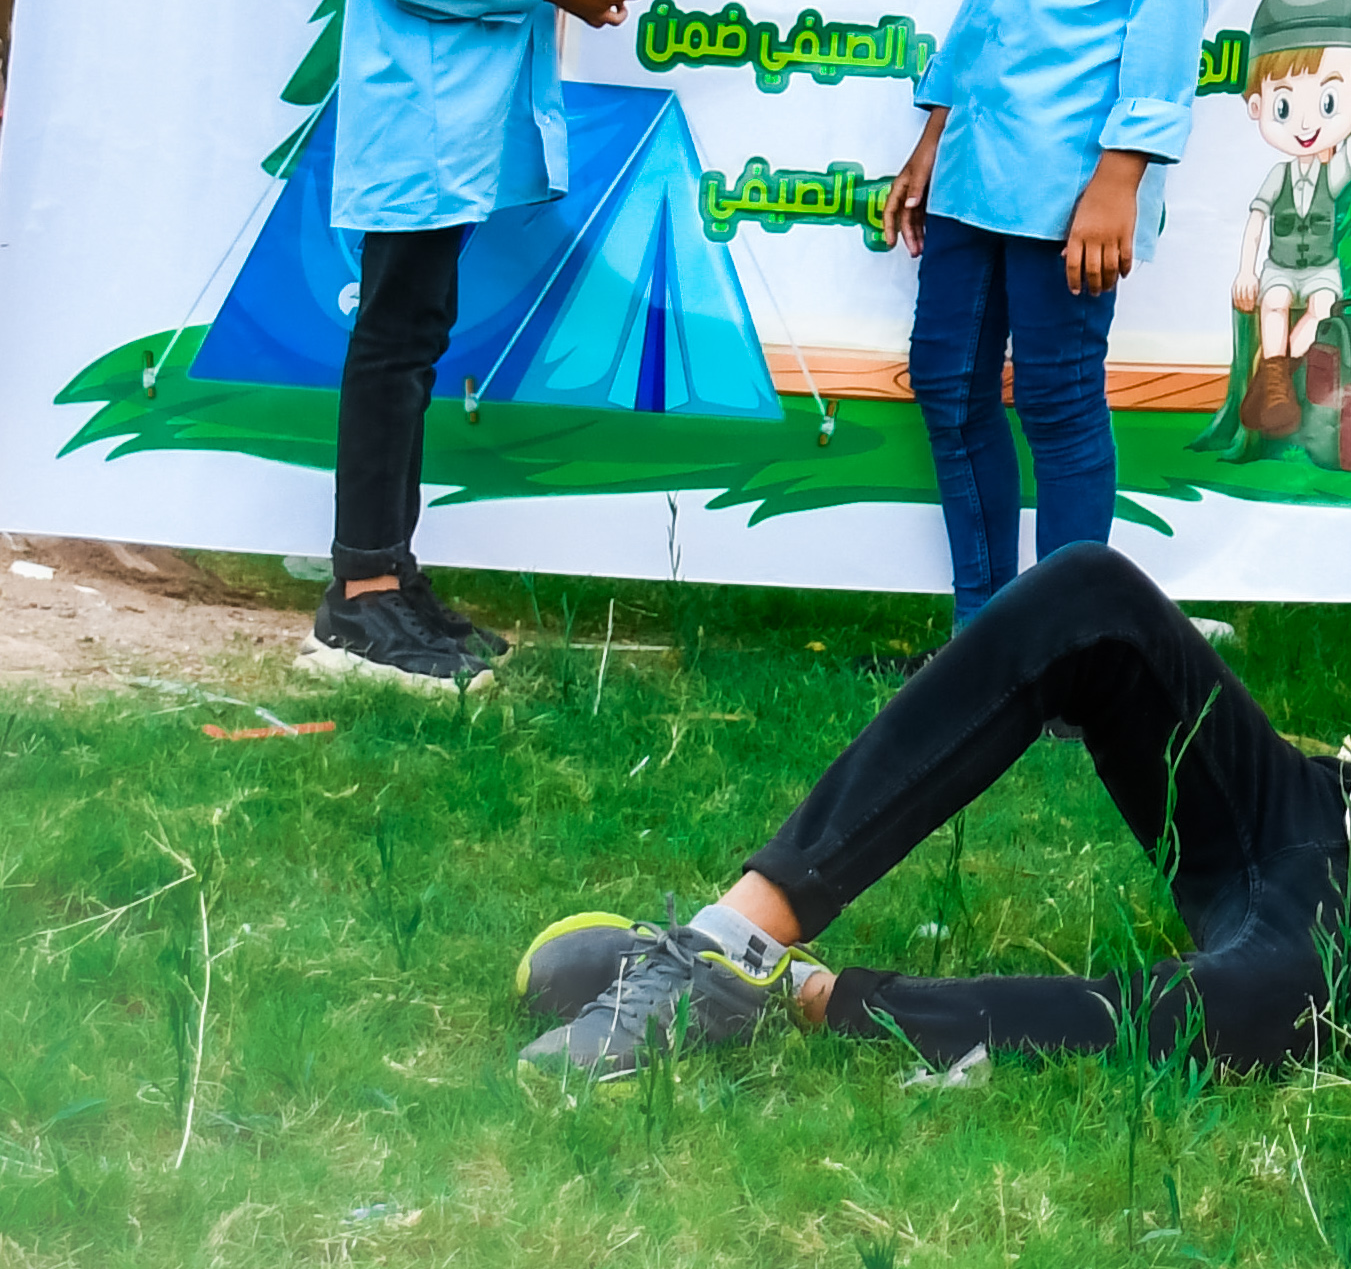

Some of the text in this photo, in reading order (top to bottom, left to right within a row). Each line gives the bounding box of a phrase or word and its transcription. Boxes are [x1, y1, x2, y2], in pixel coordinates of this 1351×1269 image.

[644, 3, 747, 63] ضمن
[759, 15, 907, 84] الصيفي
[707, 163, 855, 232] الصيفي
